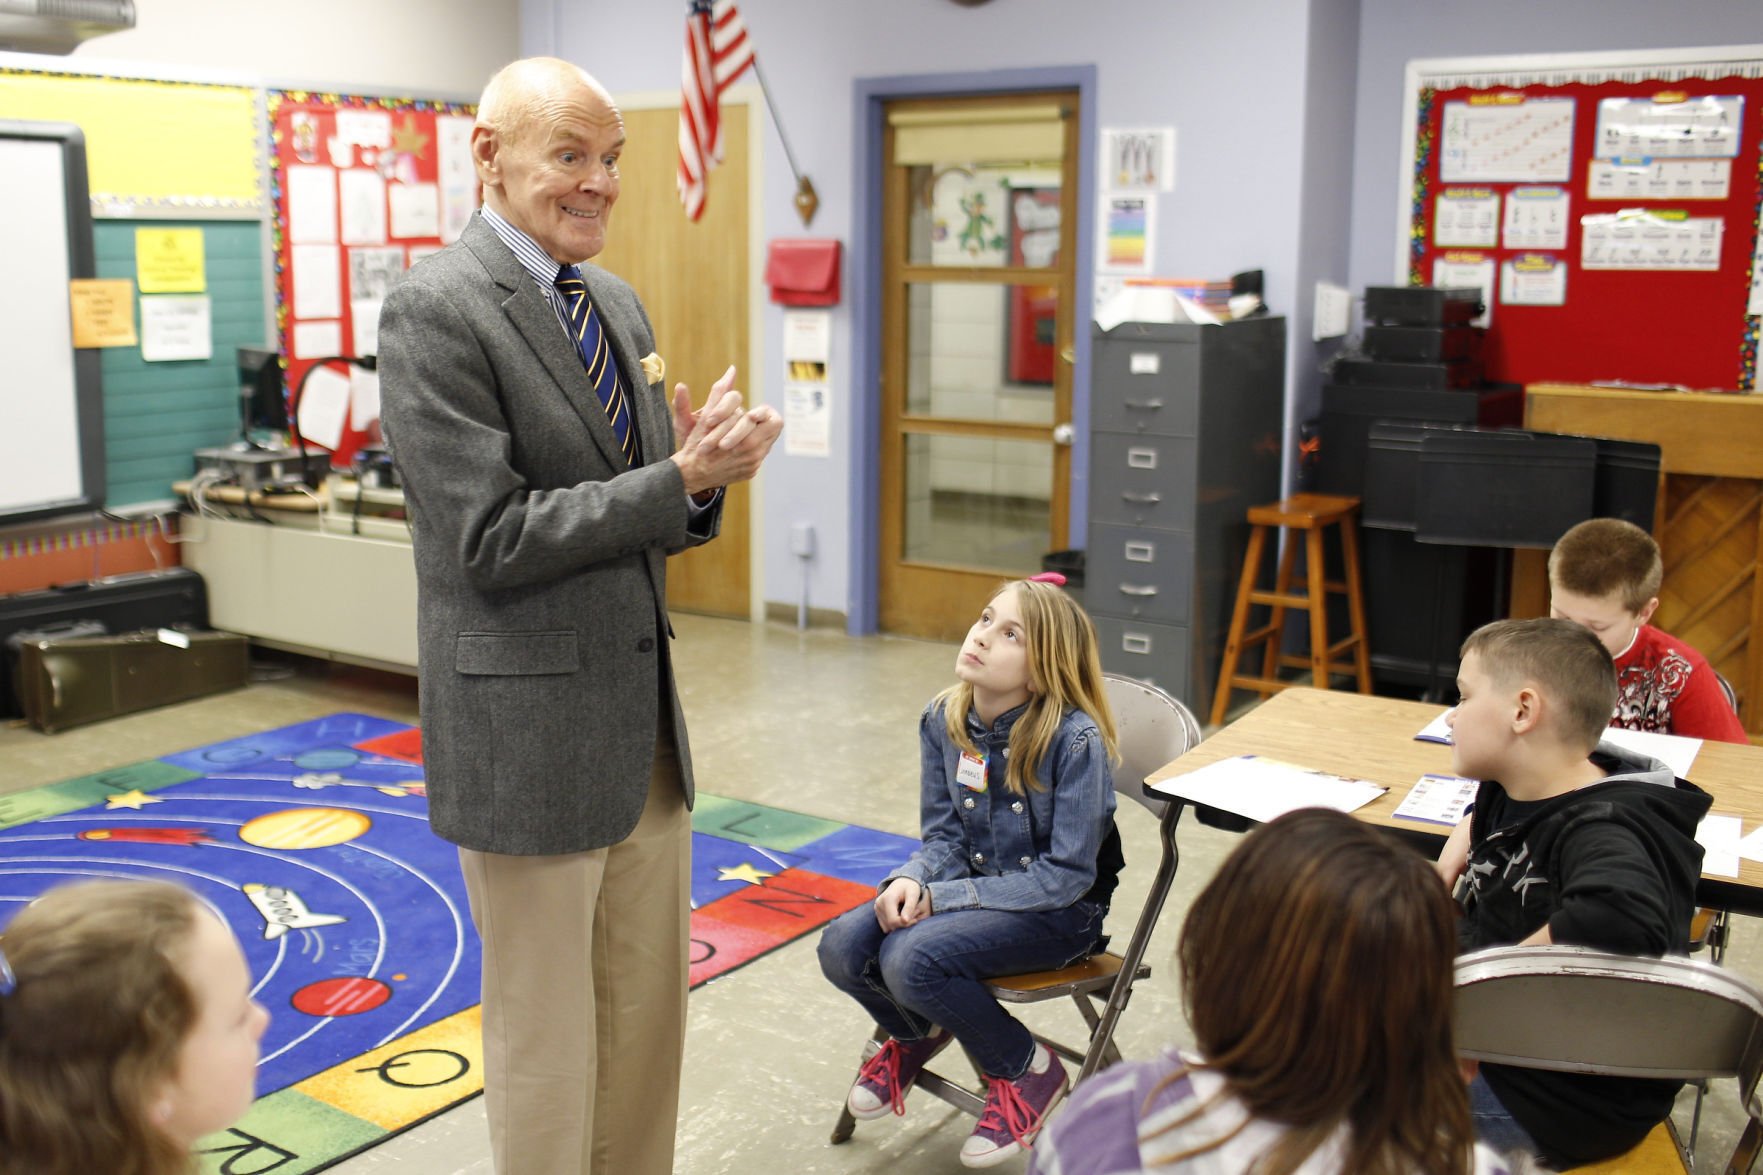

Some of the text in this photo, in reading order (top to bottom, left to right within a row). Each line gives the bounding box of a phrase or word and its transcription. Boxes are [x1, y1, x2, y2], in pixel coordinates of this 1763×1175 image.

[720, 813, 761, 837] L
[331, 938, 378, 975] Mars
[355, 1049, 470, 1088] Q
[199, 1127, 299, 1175] R
